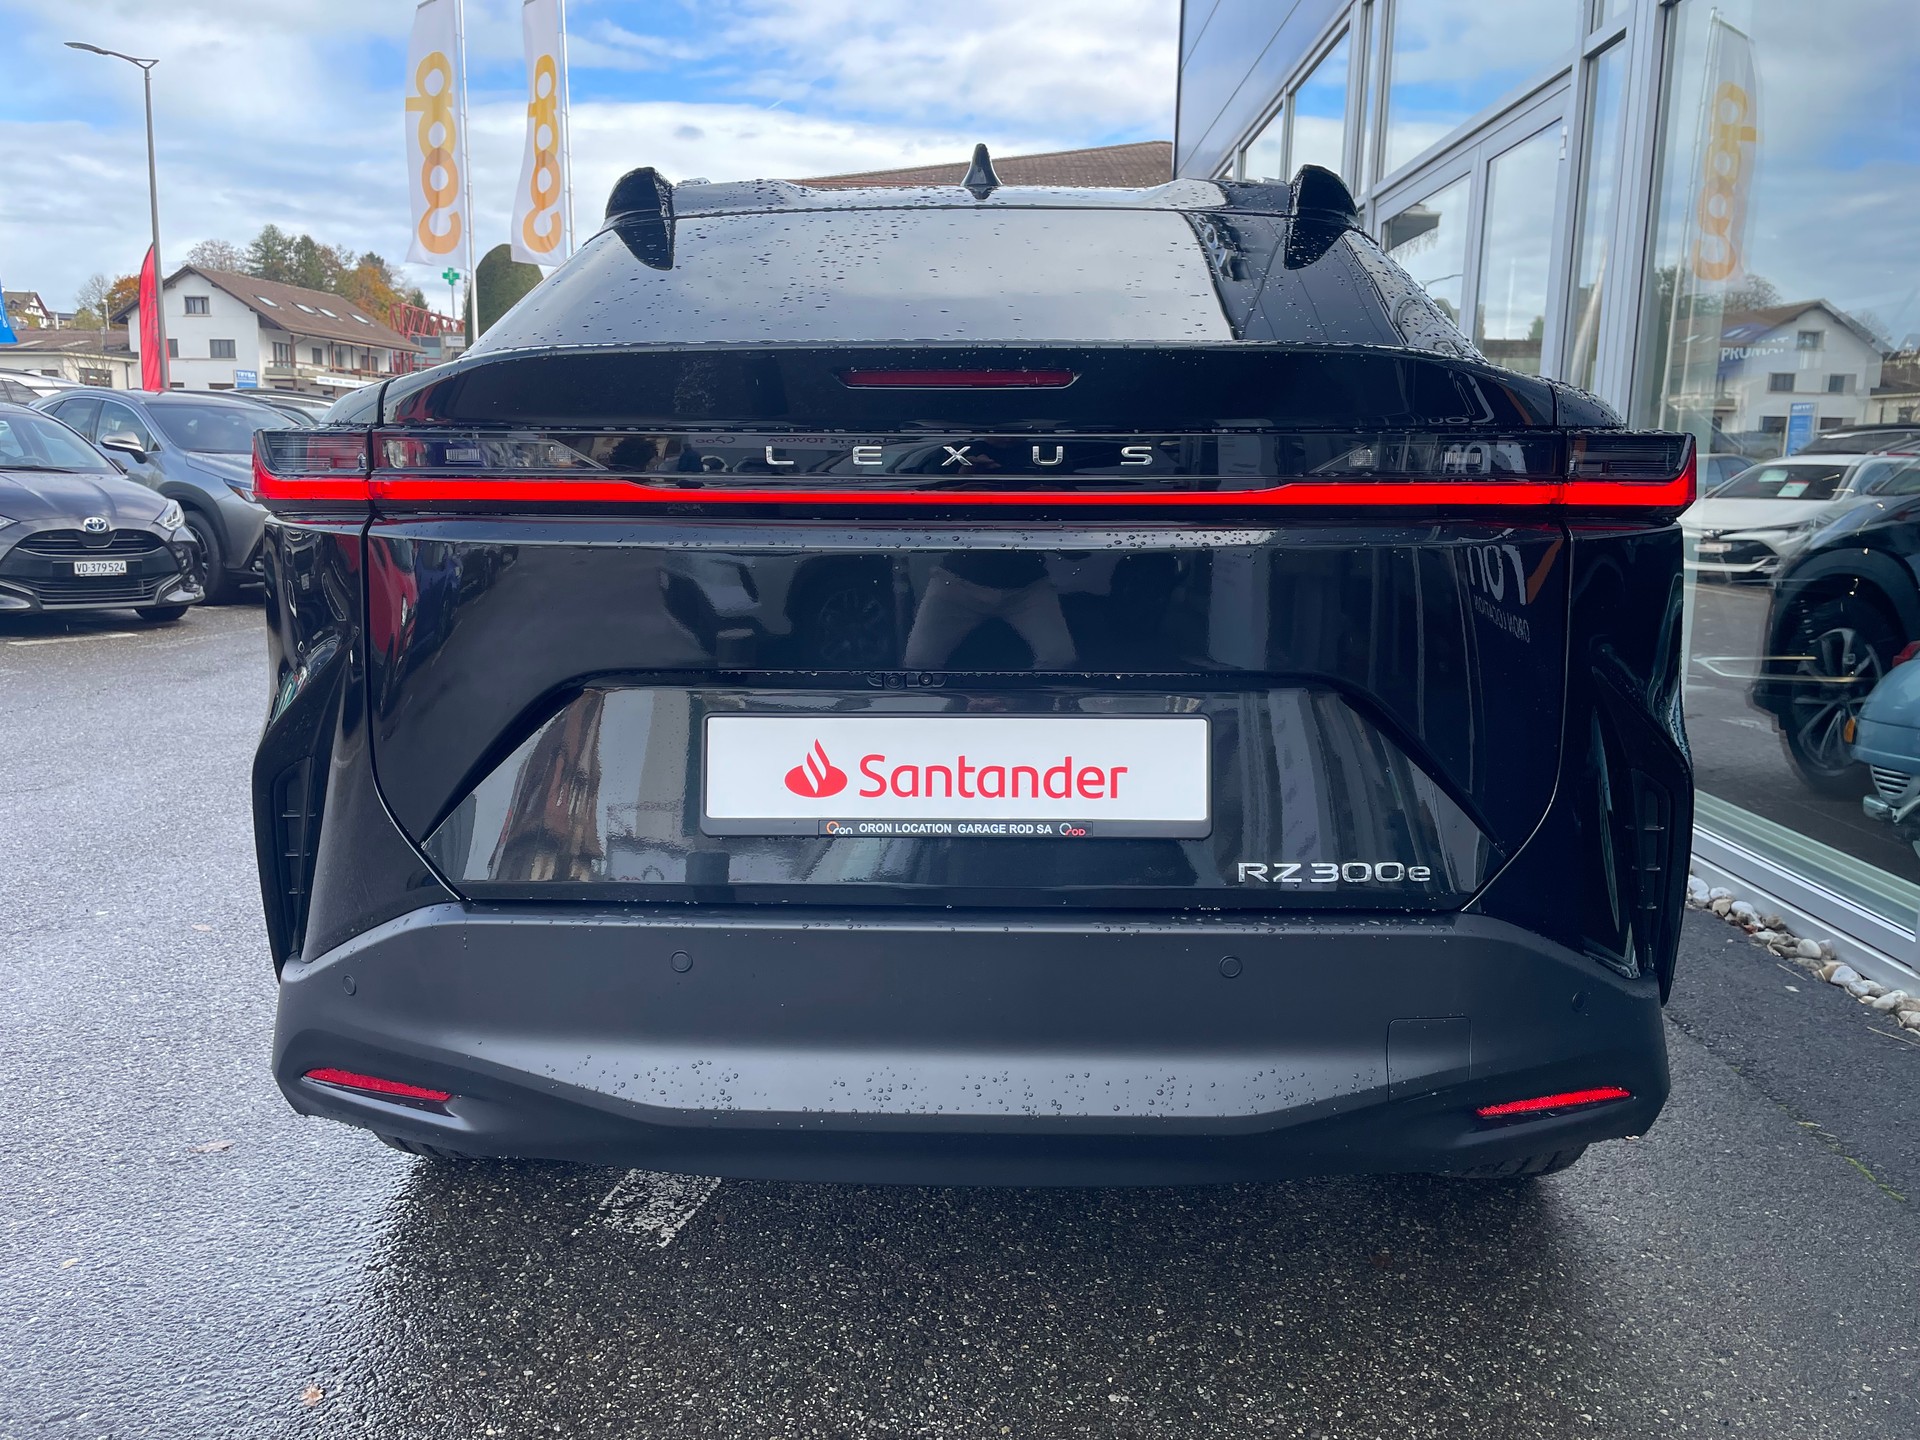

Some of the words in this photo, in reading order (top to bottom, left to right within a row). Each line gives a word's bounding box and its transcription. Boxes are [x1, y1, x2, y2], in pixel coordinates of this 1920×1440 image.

[765, 445, 1153, 467] LEXUS
[858, 754, 1129, 799] Santander
[859, 823, 892, 834] ORON
[895, 823, 952, 834] LOCATION
[957, 823, 1006, 834] GARAGE
[1009, 823, 1034, 834] ROD
[1036, 823, 1053, 834] SA
